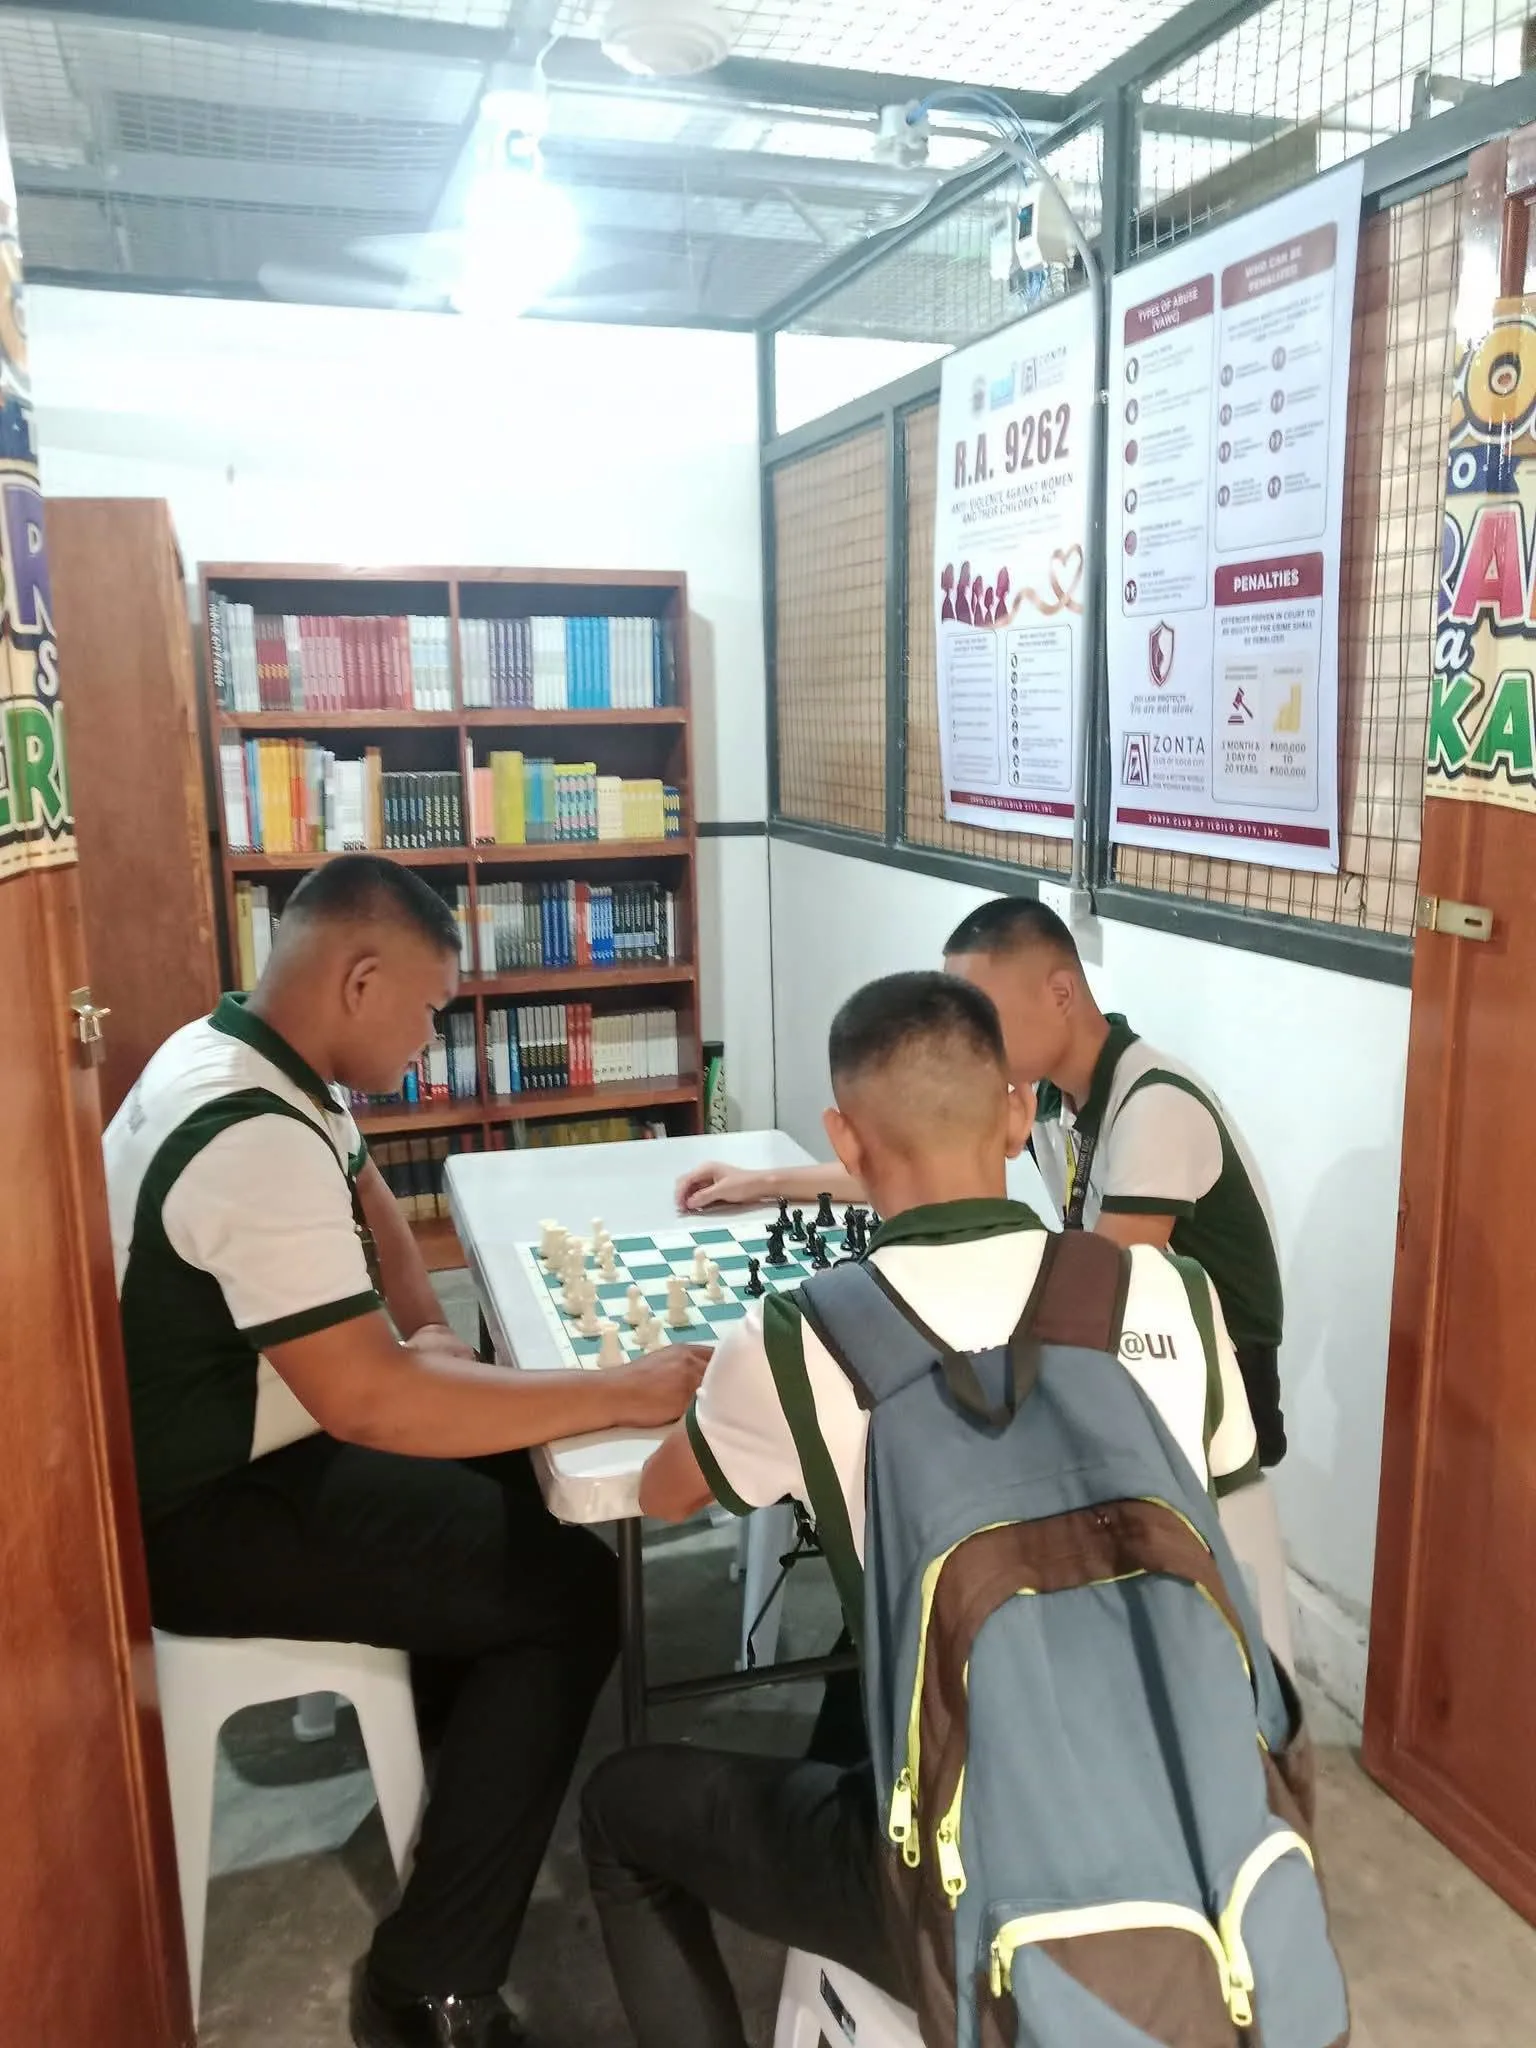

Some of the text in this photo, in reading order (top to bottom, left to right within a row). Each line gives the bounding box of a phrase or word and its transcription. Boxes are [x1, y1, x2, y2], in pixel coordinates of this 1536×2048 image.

[1138, 287, 1199, 323] TYPES OF ABUSE
[954, 433, 994, 490] R.A.
[1005, 402, 1072, 474] 9262
[1006, 481, 1038, 500] AGAINST
[1041, 472, 1074, 491] WOMEN
[1000, 495, 1039, 516] CHILDREN
[1234, 568, 1300, 593] PENALTIES
[1153, 735, 1205, 755] ZONTA
[1227, 741, 1253, 751] MONTH
[1231, 753, 1246, 762] DAY
[1248, 753, 1257, 762] TO
[1225, 764, 1258, 775] 20 YEARS
[1173, 815, 1192, 828] CLUB
